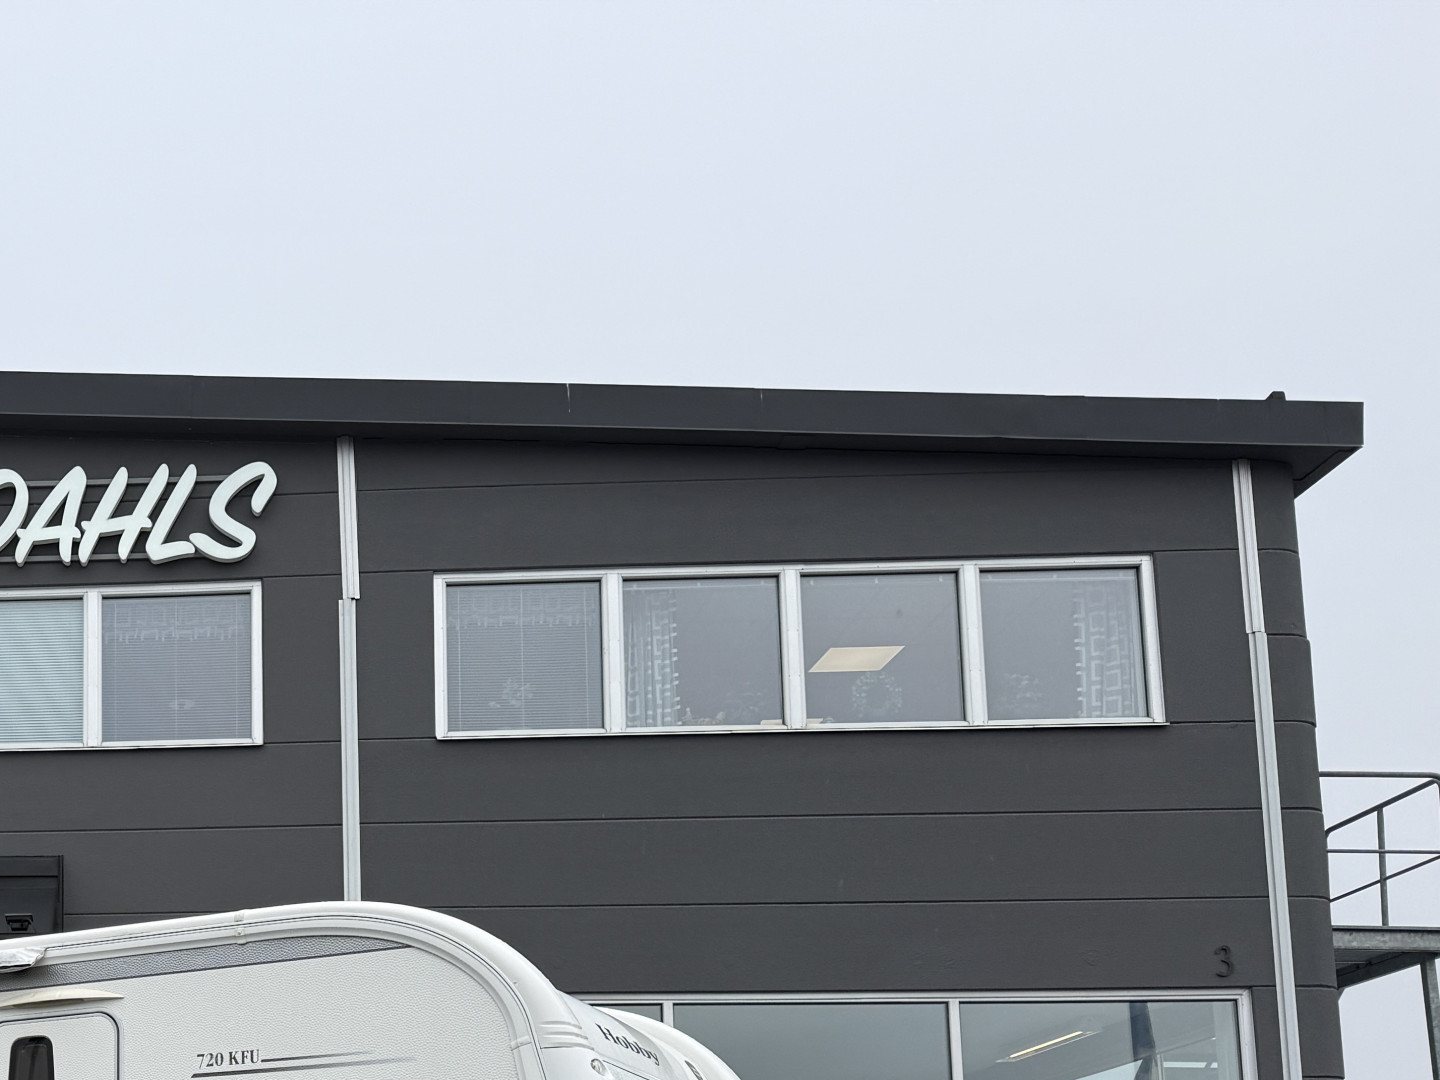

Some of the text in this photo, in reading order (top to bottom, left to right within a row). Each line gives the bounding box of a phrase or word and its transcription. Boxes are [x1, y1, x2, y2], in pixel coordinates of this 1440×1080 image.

[1214, 944, 1235, 978] 3
[196, 1049, 260, 1070] 720 KFU
[594, 1022, 660, 1067] Hobby
